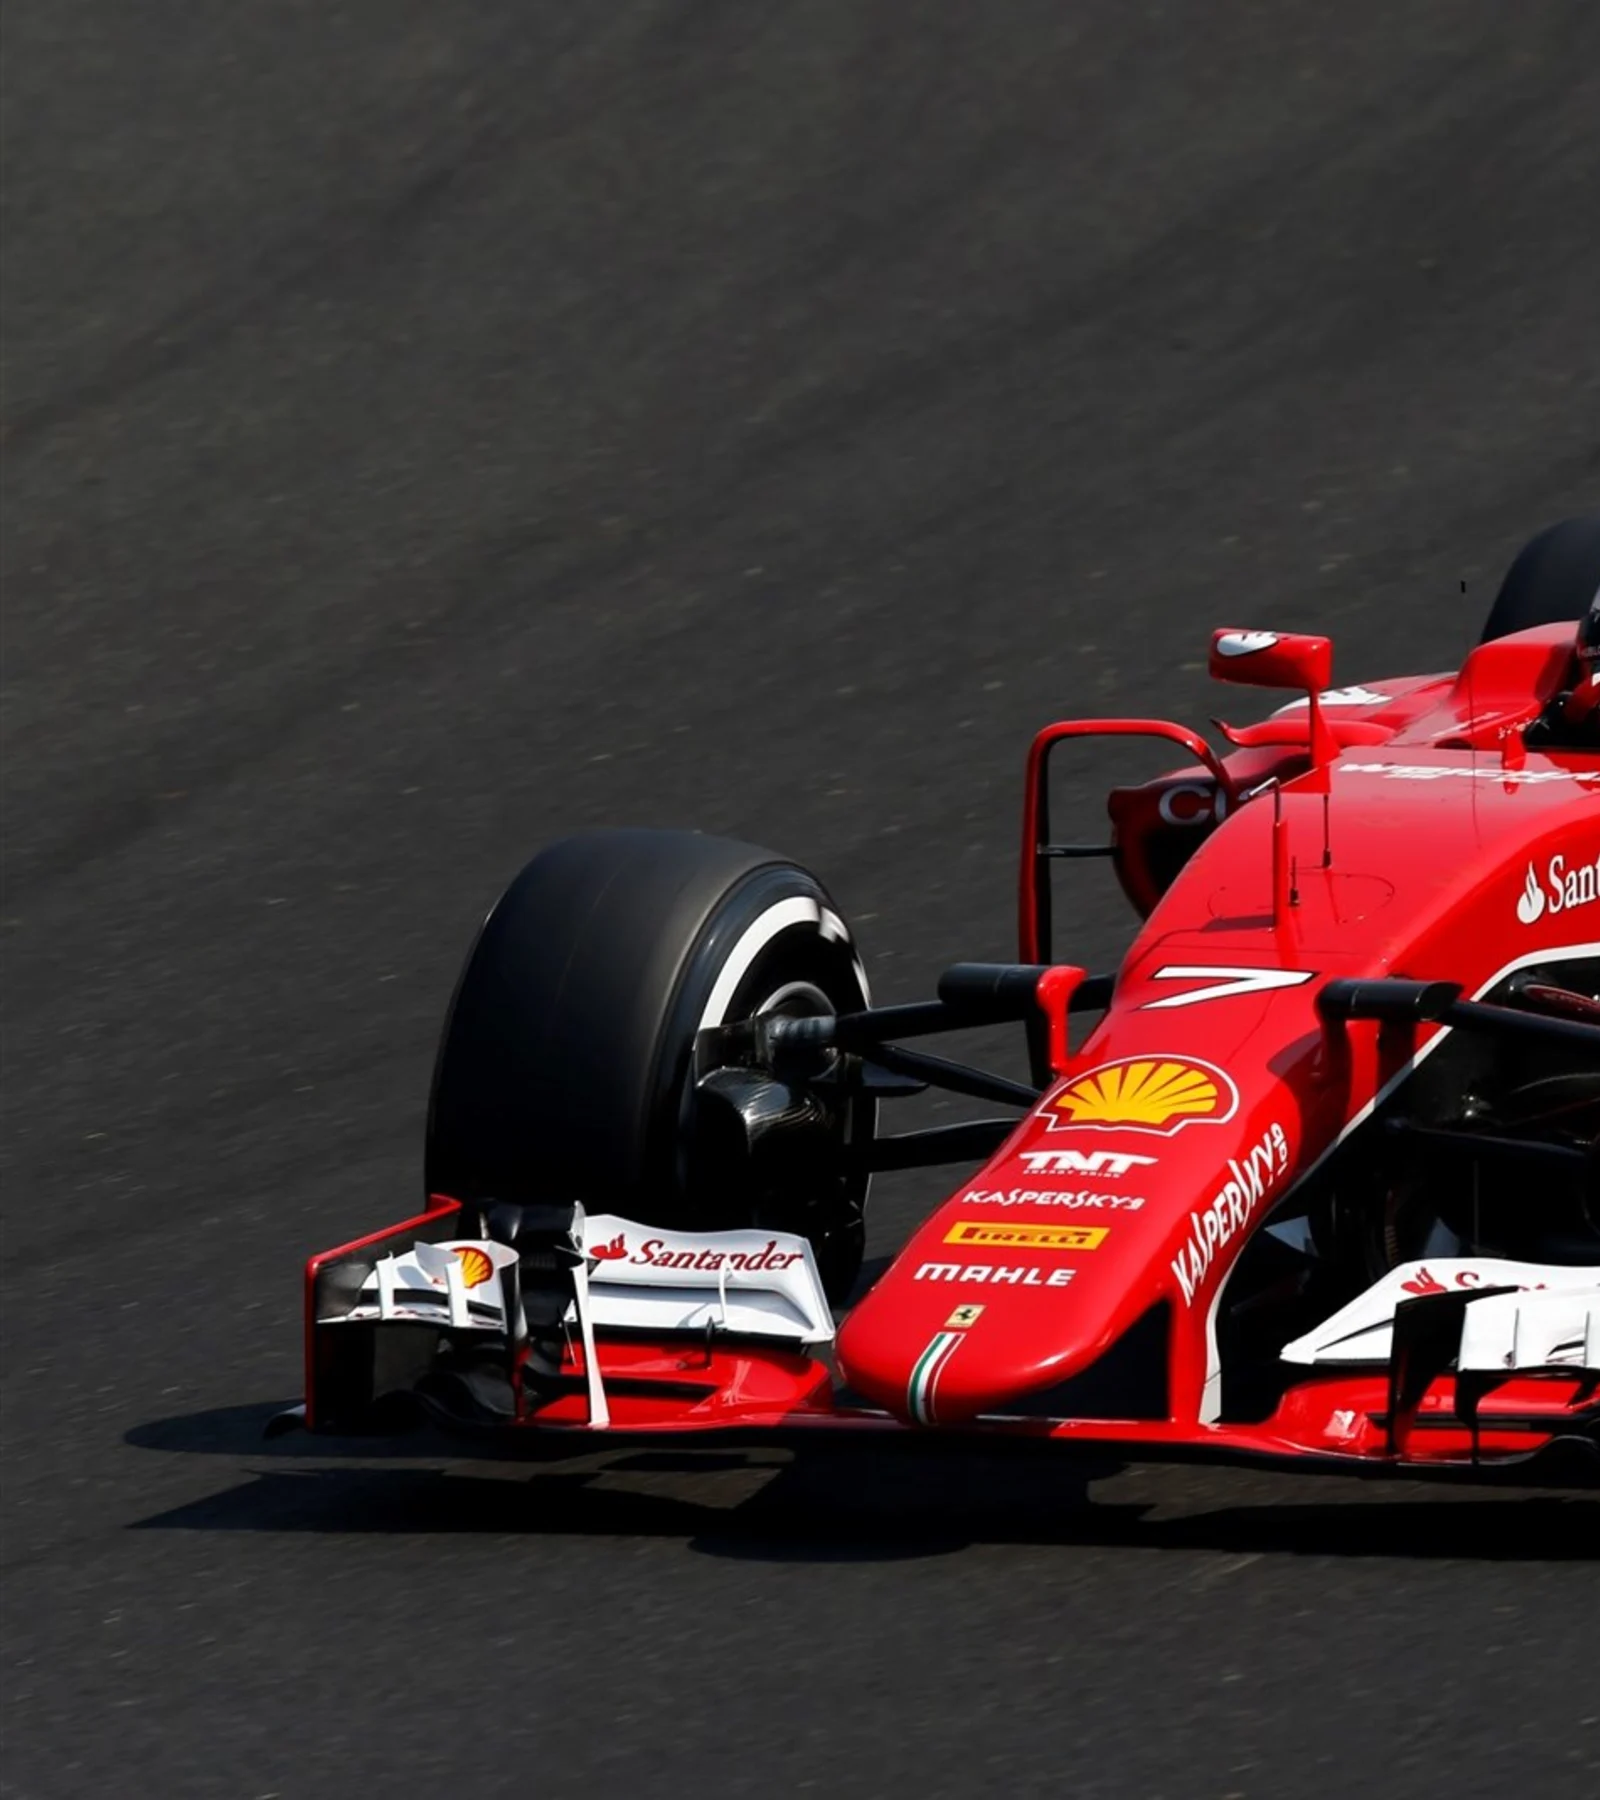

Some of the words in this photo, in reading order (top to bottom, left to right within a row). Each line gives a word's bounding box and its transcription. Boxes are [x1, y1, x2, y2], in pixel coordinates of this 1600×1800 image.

[1139, 966, 1317, 1010] 7
[1018, 1150, 1159, 1174] TNT
[962, 1188, 1131, 1210] KASPERSKY
[1170, 1132, 1276, 1308] KASPERSKY
[628, 1240, 803, 1271] Santander
[913, 1262, 1077, 1286] MAHLE
